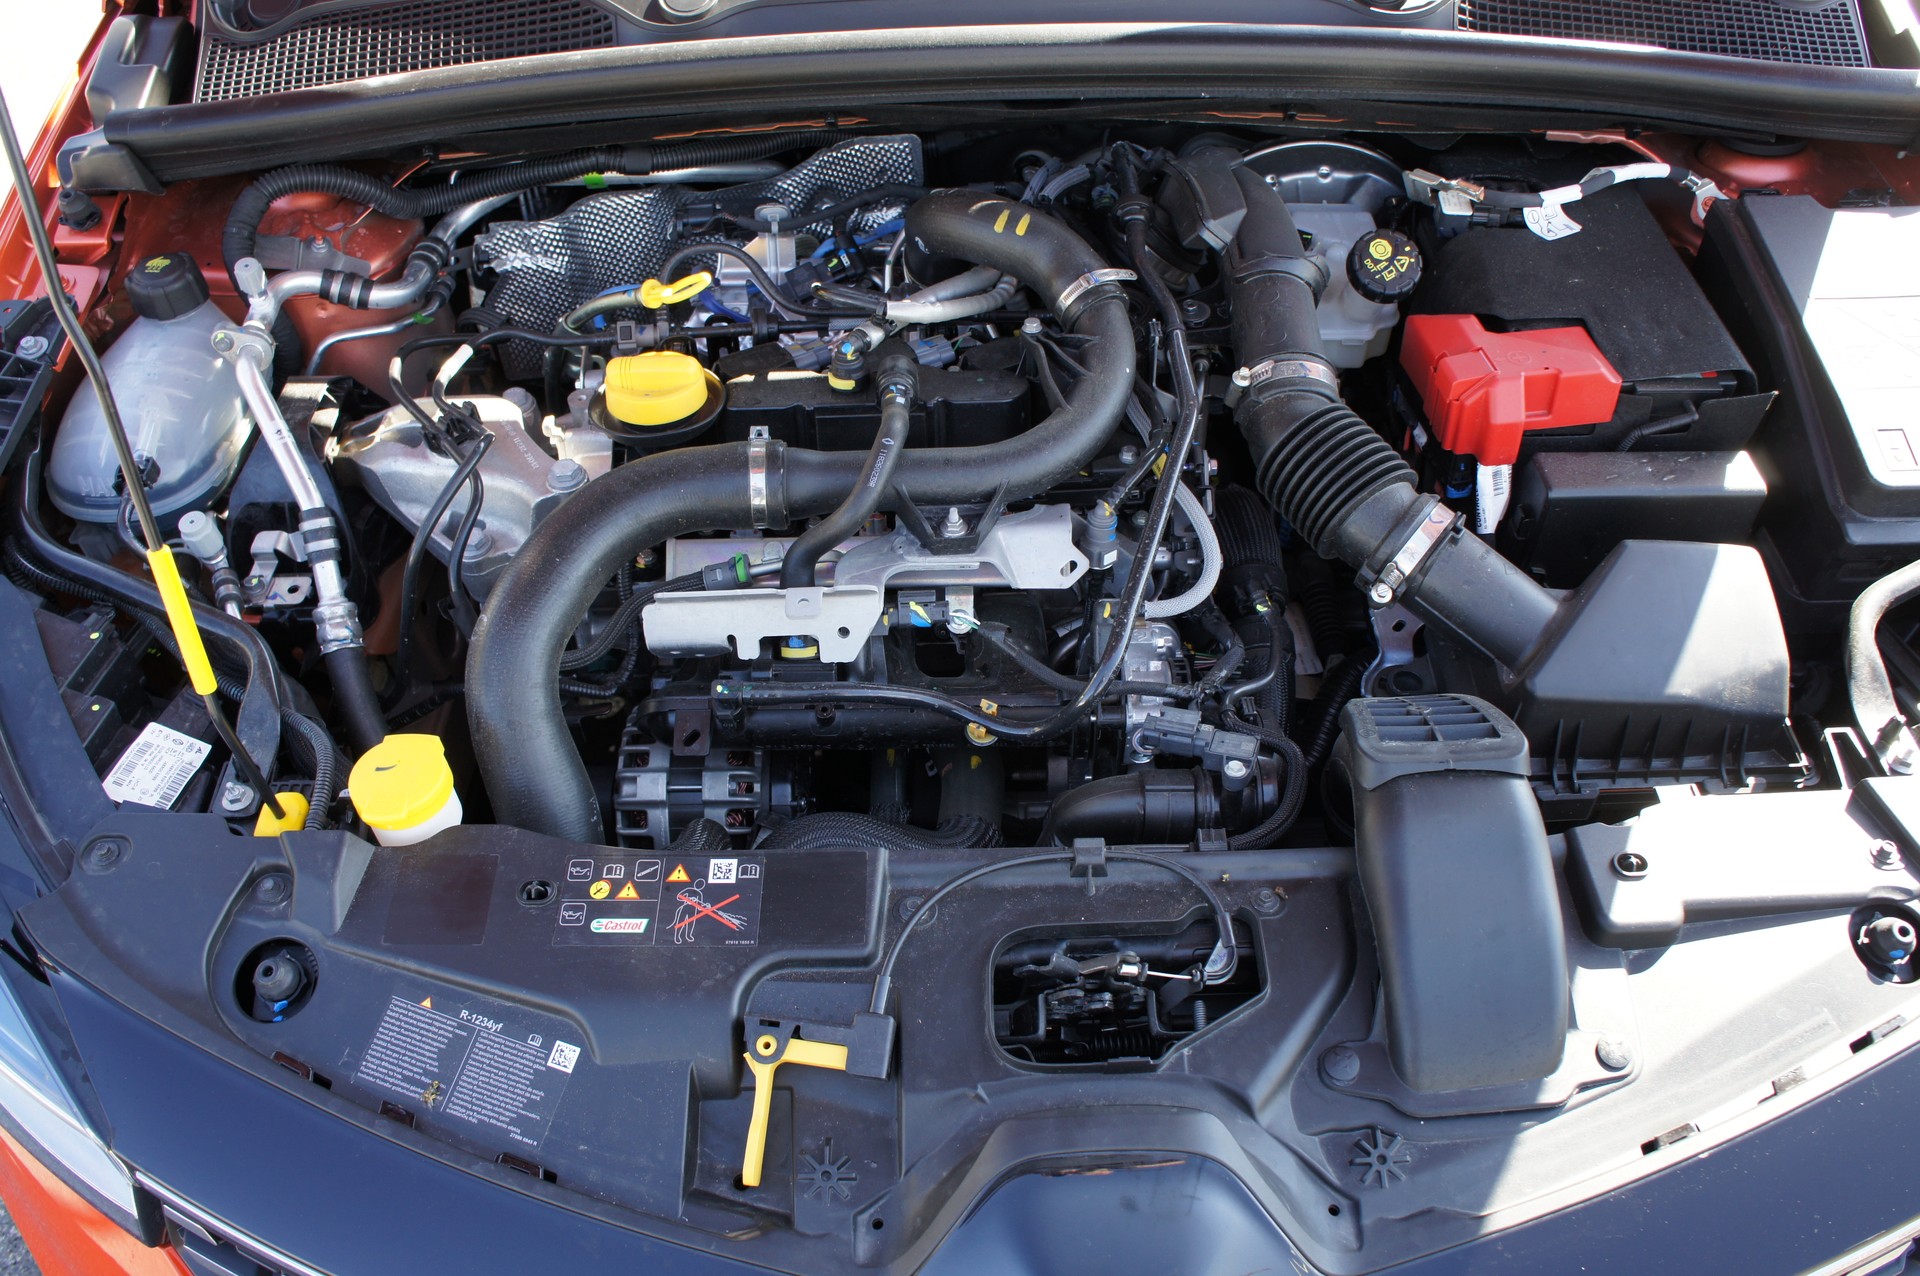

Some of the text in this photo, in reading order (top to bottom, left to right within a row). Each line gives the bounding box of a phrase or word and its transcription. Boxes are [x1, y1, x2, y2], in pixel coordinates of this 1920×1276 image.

[1364, 258, 1378, 272] DOT
[604, 920, 644, 930] Castrol
[460, 1010, 504, 1032] R-1234yf
